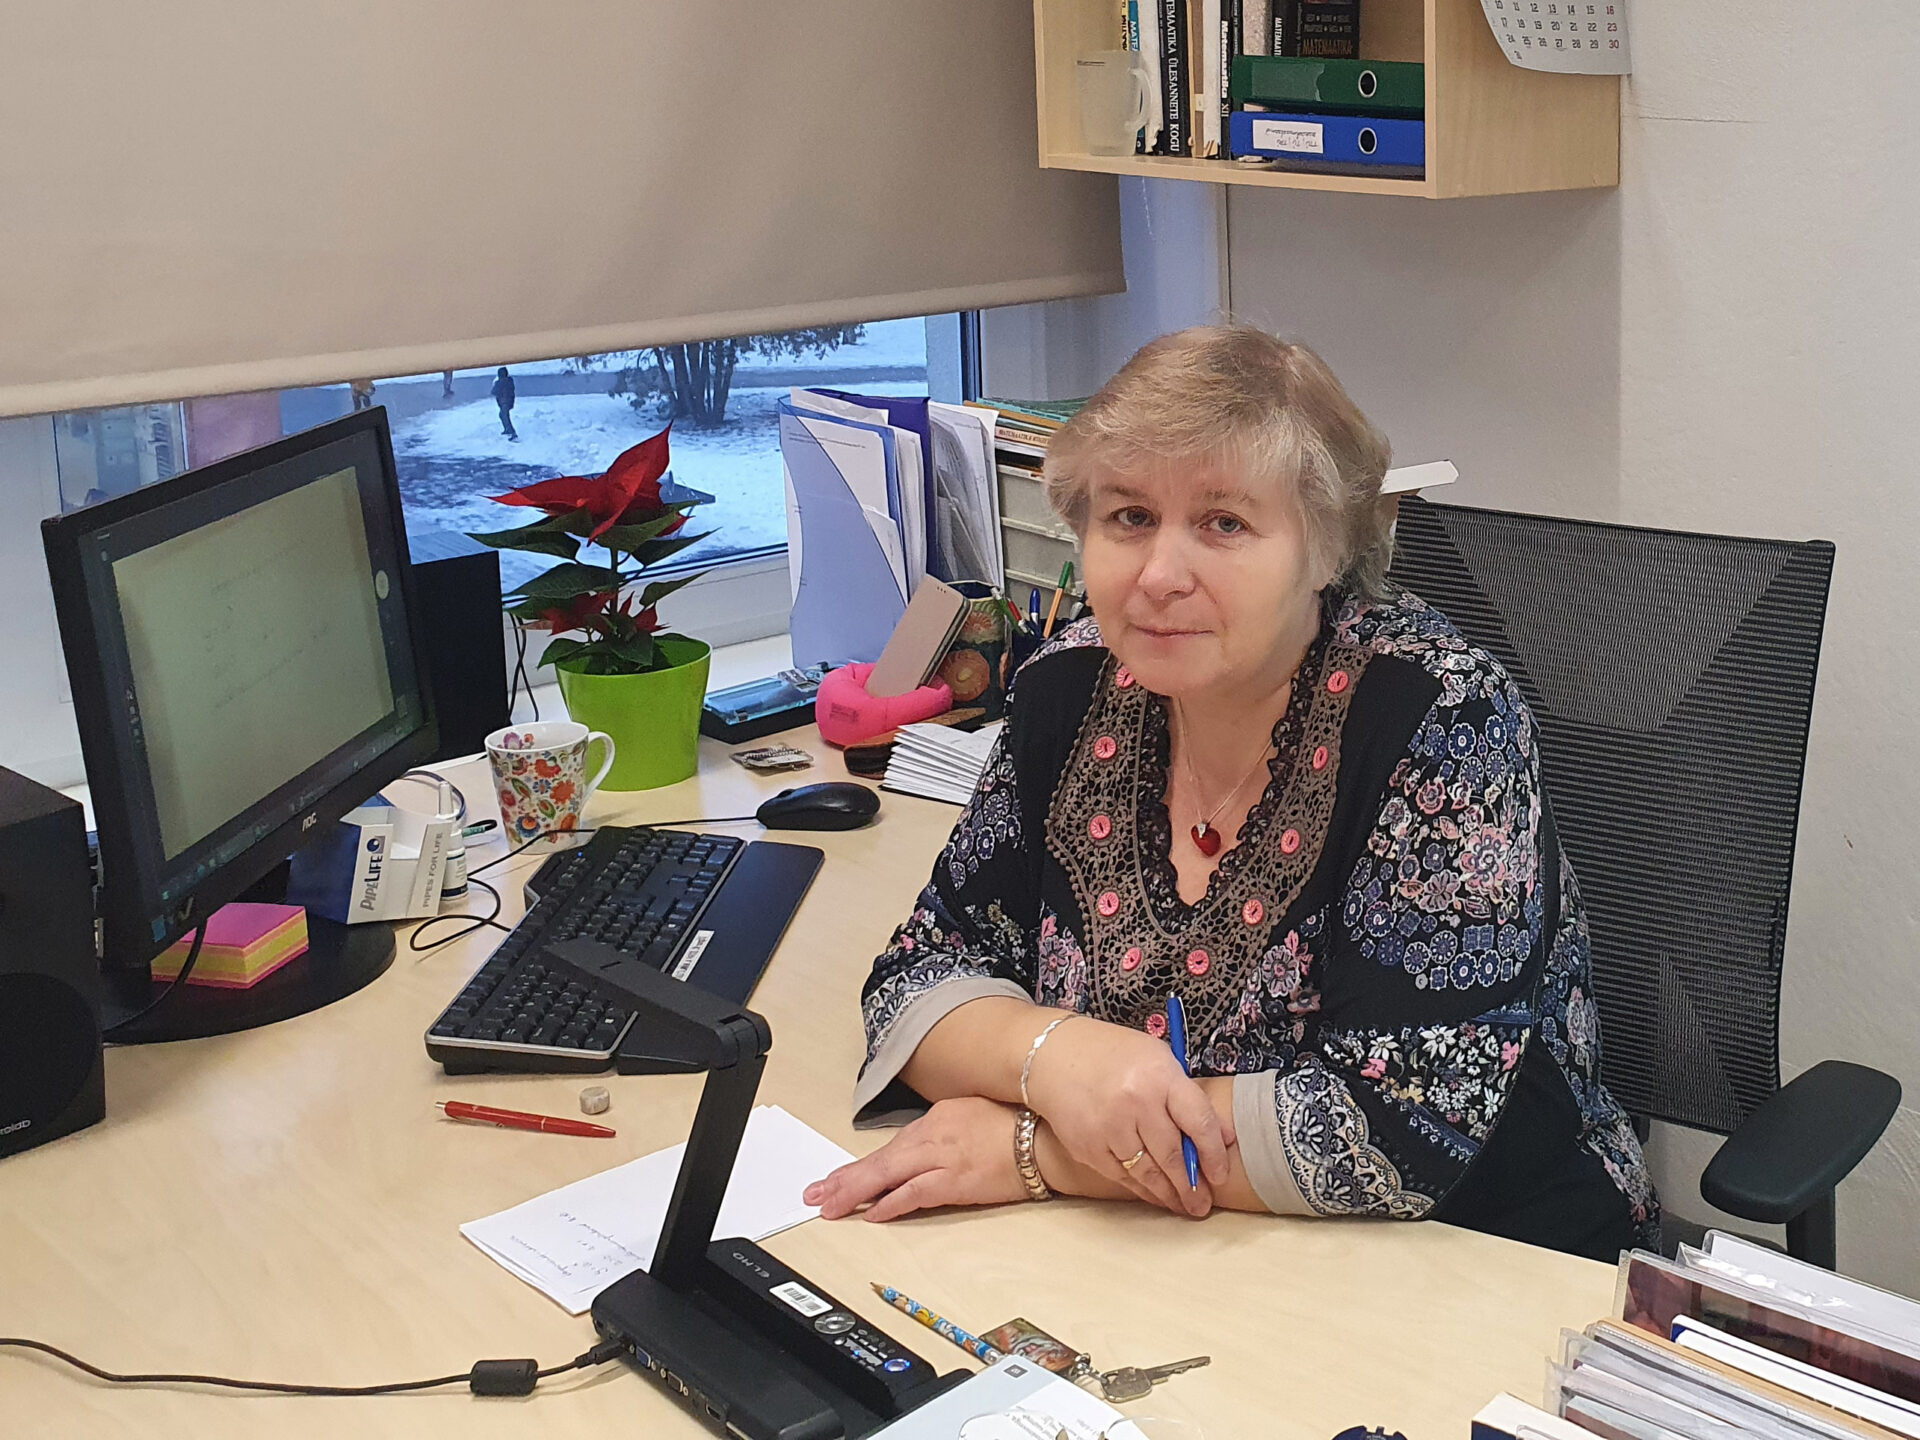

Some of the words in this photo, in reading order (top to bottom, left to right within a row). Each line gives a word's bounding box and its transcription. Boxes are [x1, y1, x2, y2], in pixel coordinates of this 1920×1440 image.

[1530, 3, 1539, 13] 12
[1548, 3, 1557, 14] 13
[1567, 4, 1576, 15] 14
[1586, 5, 1595, 15] 15
[1606, 6, 1614, 15] 16
[1551, 21, 1560, 31] 20
[1569, 21, 1578, 32] 21
[1587, 23, 1597, 32] 22
[1607, 22, 1618, 33] 23
[1555, 39, 1563, 48] 27
[1572, 39, 1581, 49] 28
[1590, 40, 1599, 49] 29
[1608, 39, 1619, 49] 30
[1221, 20, 1229, 99] Matemaatika
[1168, 57, 1180, 120] ÜLESANNETE
[1221, 103, 1229, 118] XII
[1169, 123, 1180, 152] KOGU
[433, 832, 443, 855] LIFE
[427, 856, 439, 877] FOR
[423, 877, 435, 908] PIPES
[732, 1252, 771, 1279] ELMO
